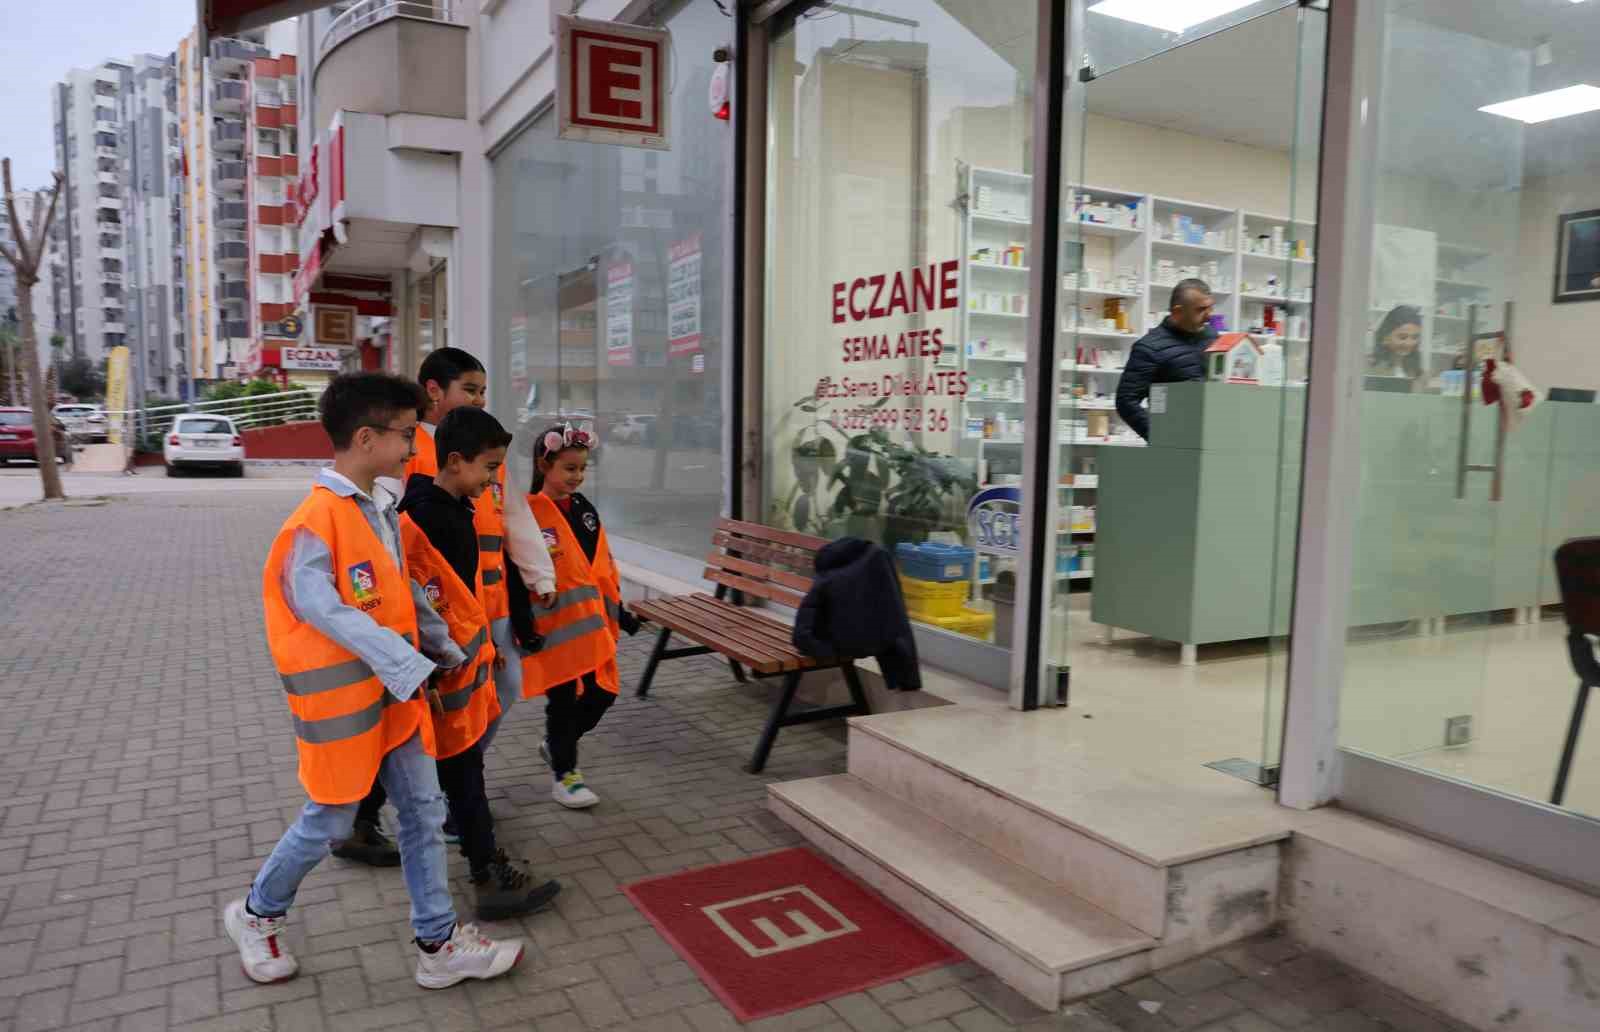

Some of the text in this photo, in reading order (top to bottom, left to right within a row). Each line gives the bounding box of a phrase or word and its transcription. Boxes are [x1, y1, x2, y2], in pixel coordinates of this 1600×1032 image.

[589, 44, 642, 119] E
[832, 260, 959, 324] ECZANE
[287, 349, 345, 361] ECZAN
[842, 328, 943, 364] SEMA ATEŞ
[903, 408, 923, 432] 52
[928, 408, 949, 432] 36
